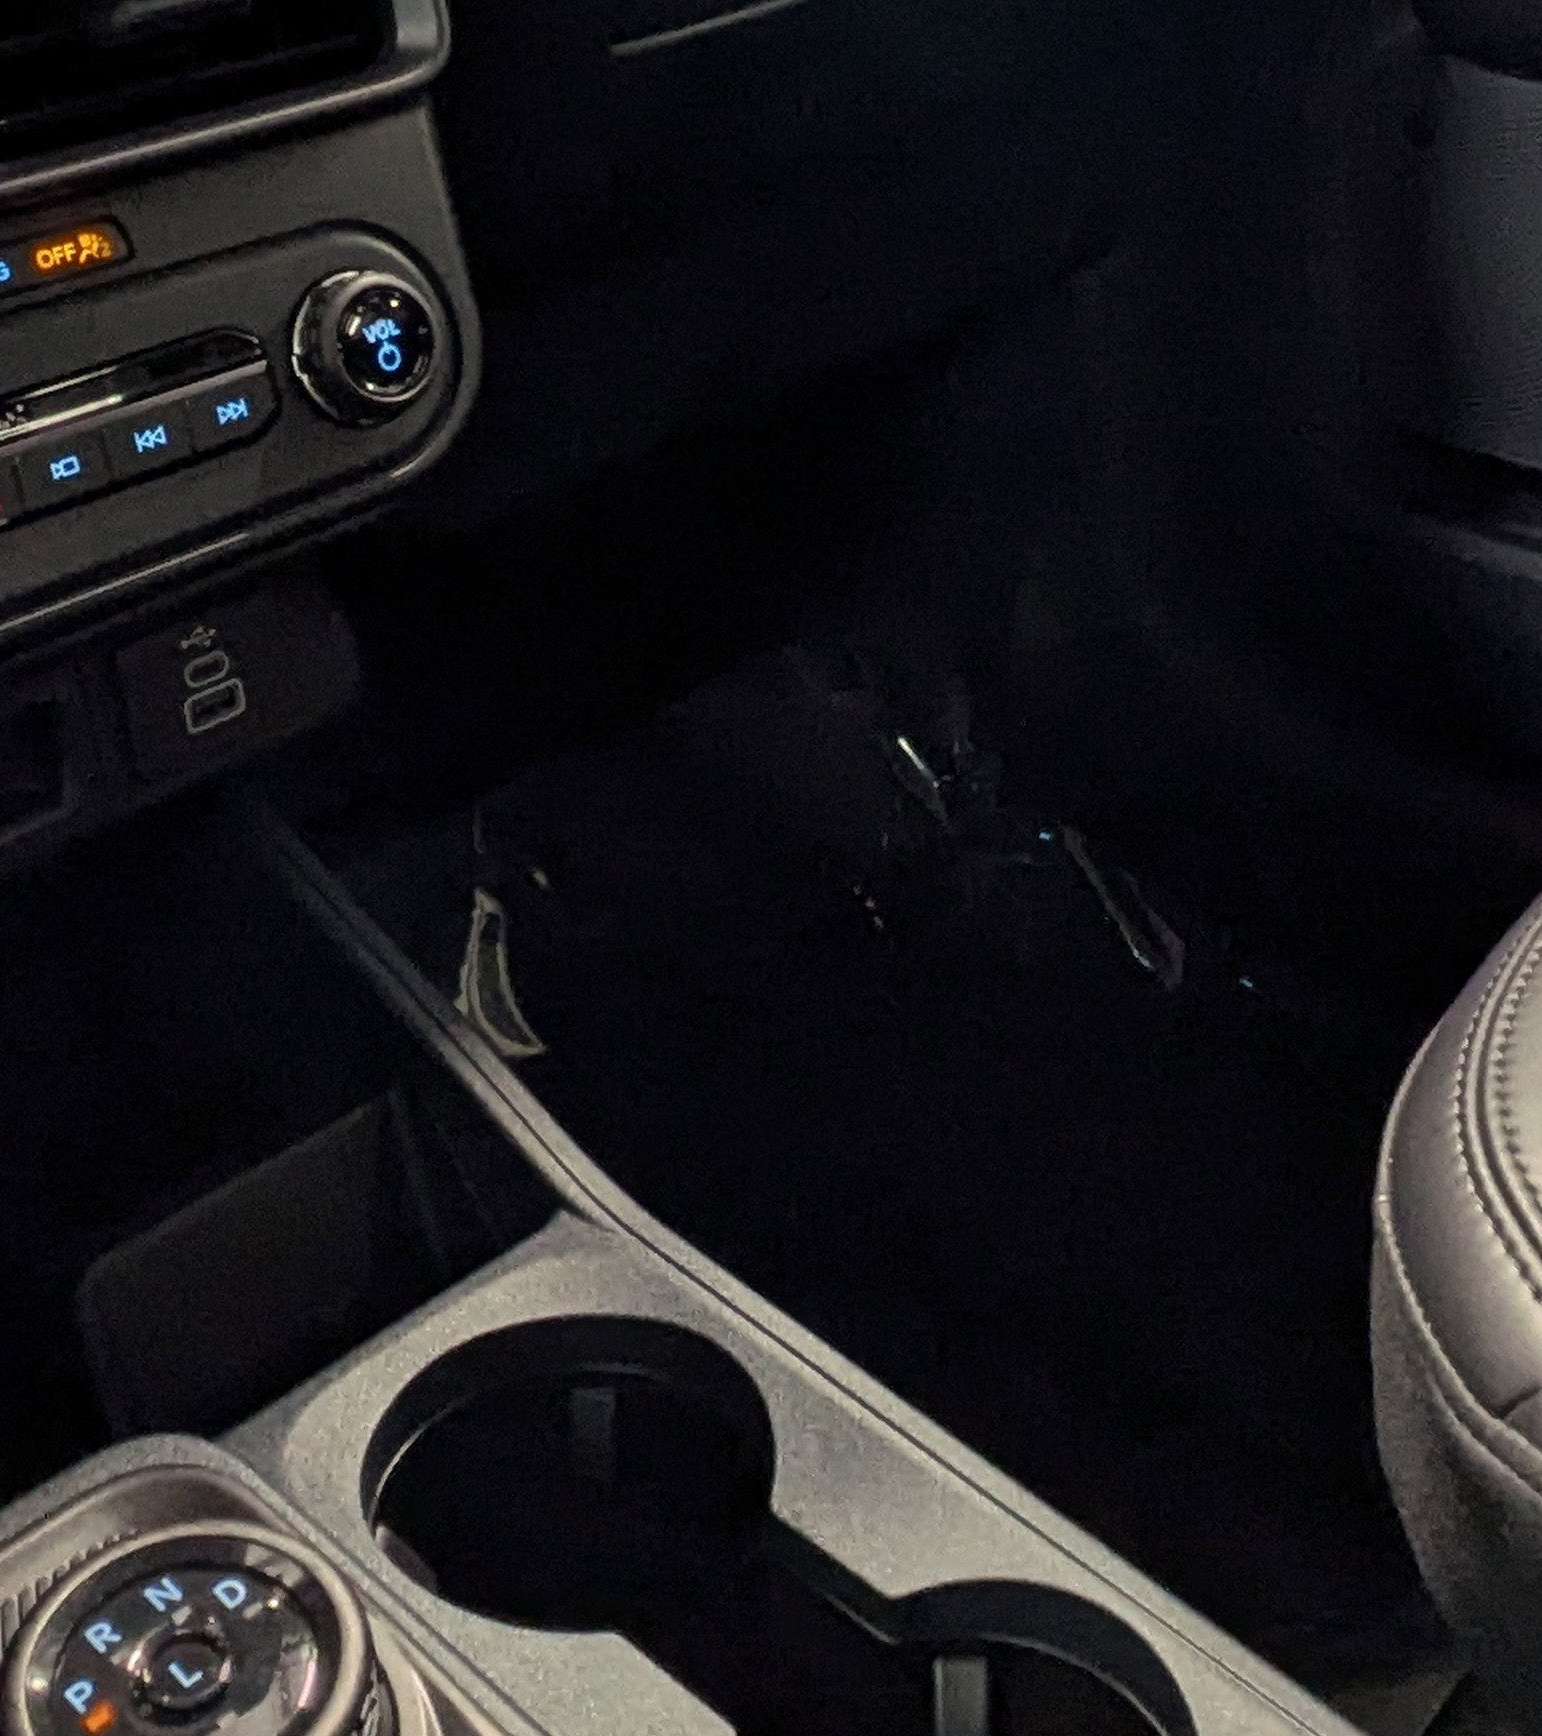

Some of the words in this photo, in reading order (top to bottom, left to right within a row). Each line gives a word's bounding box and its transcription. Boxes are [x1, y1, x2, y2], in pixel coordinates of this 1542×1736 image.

[35, 242, 76, 270] OFF
[362, 318, 401, 344] VOL
[63, 1680, 95, 1715] P
[83, 1622, 123, 1655] R
[143, 1576, 183, 1612] N
[211, 1579, 247, 1611] D
[167, 1662, 204, 1689] L
